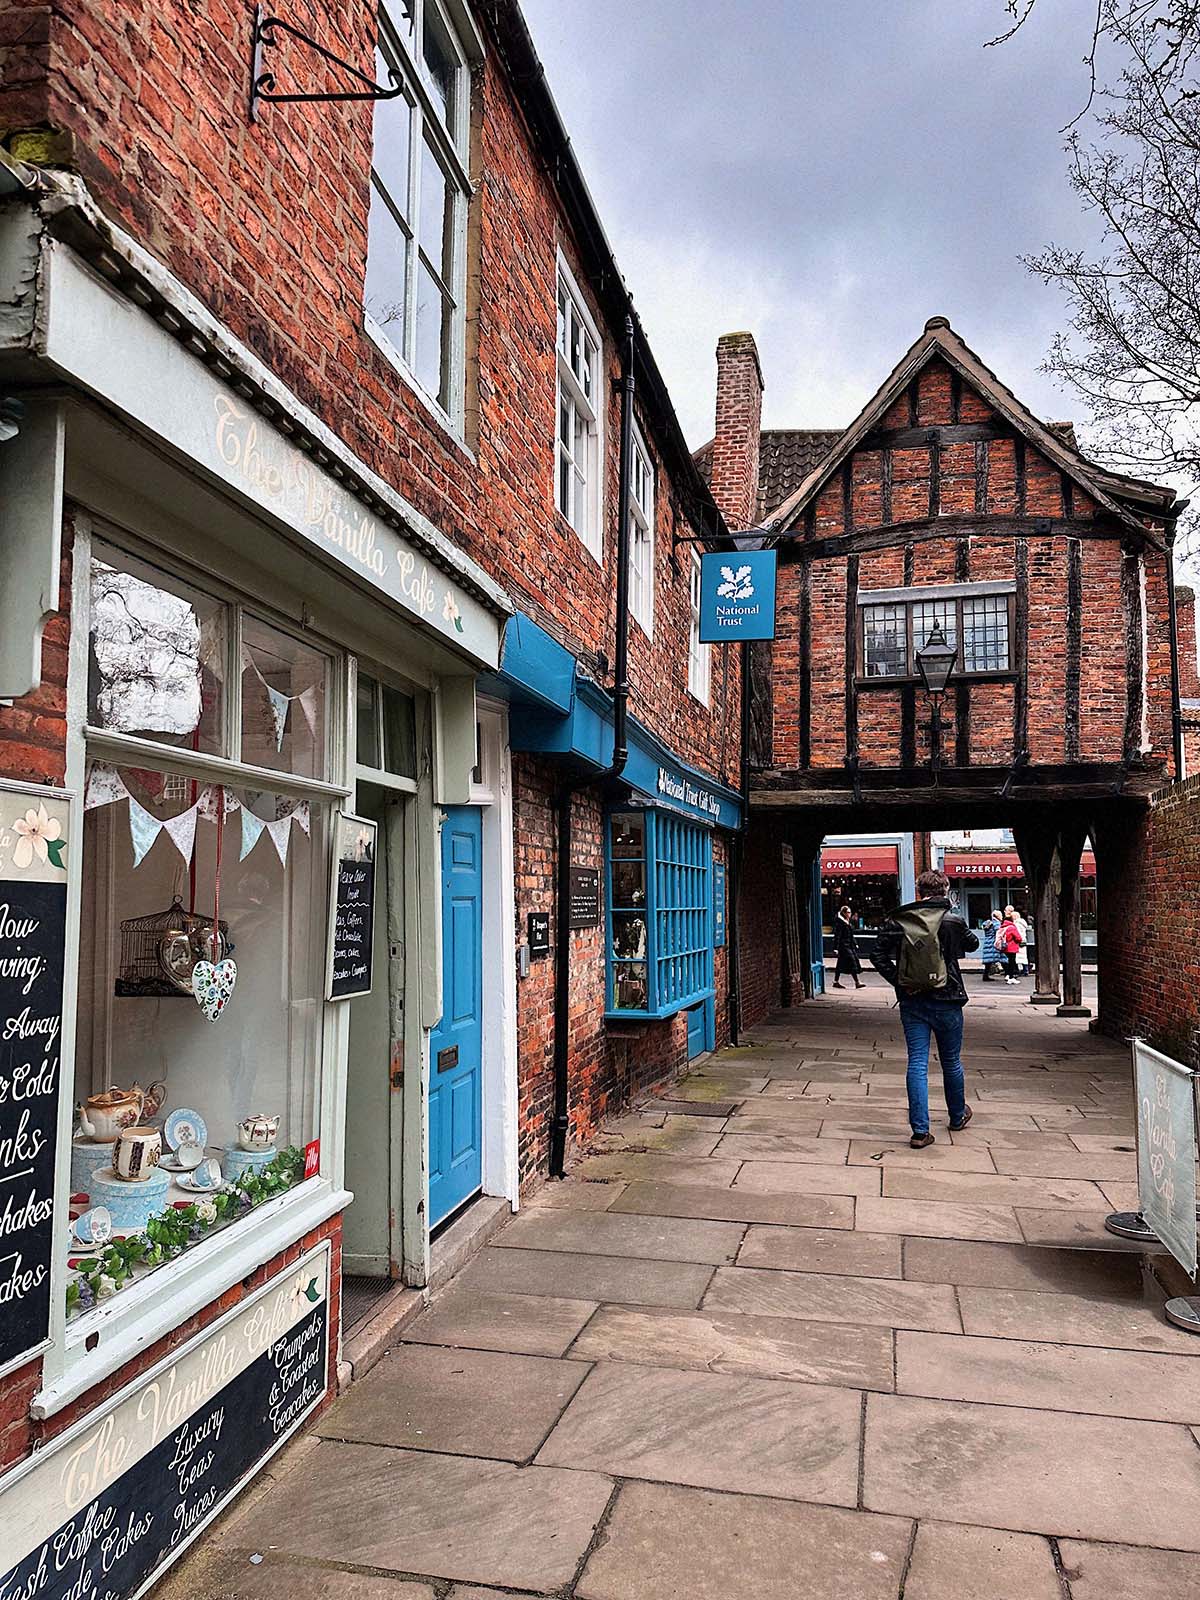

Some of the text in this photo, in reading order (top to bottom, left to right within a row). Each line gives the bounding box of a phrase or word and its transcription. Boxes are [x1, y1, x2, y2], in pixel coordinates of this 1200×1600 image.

[214, 393, 436, 616] The Vanilla Café
[715, 604, 760, 616] National
[716, 616, 743, 627] Trust
[686, 782, 699, 806] Trust
[699, 790, 709, 811] Gift
[709, 795, 721, 822] Shop
[955, 865, 1002, 873] PIZZERIA
[1006, 865, 1012, 873] &
[2, 1006, 60, 1052] Away
[12, 1057, 59, 1101] Cold
[0, 1188, 53, 1238] hakes
[0, 1253, 48, 1304] akes
[274, 1312, 324, 1369] Crumpets
[268, 1336, 321, 1406] & Toasted
[268, 1376, 319, 1434] Teacakes
[61, 1414, 133, 1508] The
[136, 1366, 242, 1447] Vanilla
[168, 1406, 225, 1471] Luxury
[177, 1450, 216, 1495] Teas
[53, 1500, 118, 1571] Coffee
[100, 1511, 154, 1572] Cakes
[170, 1485, 218, 1546] Juices
